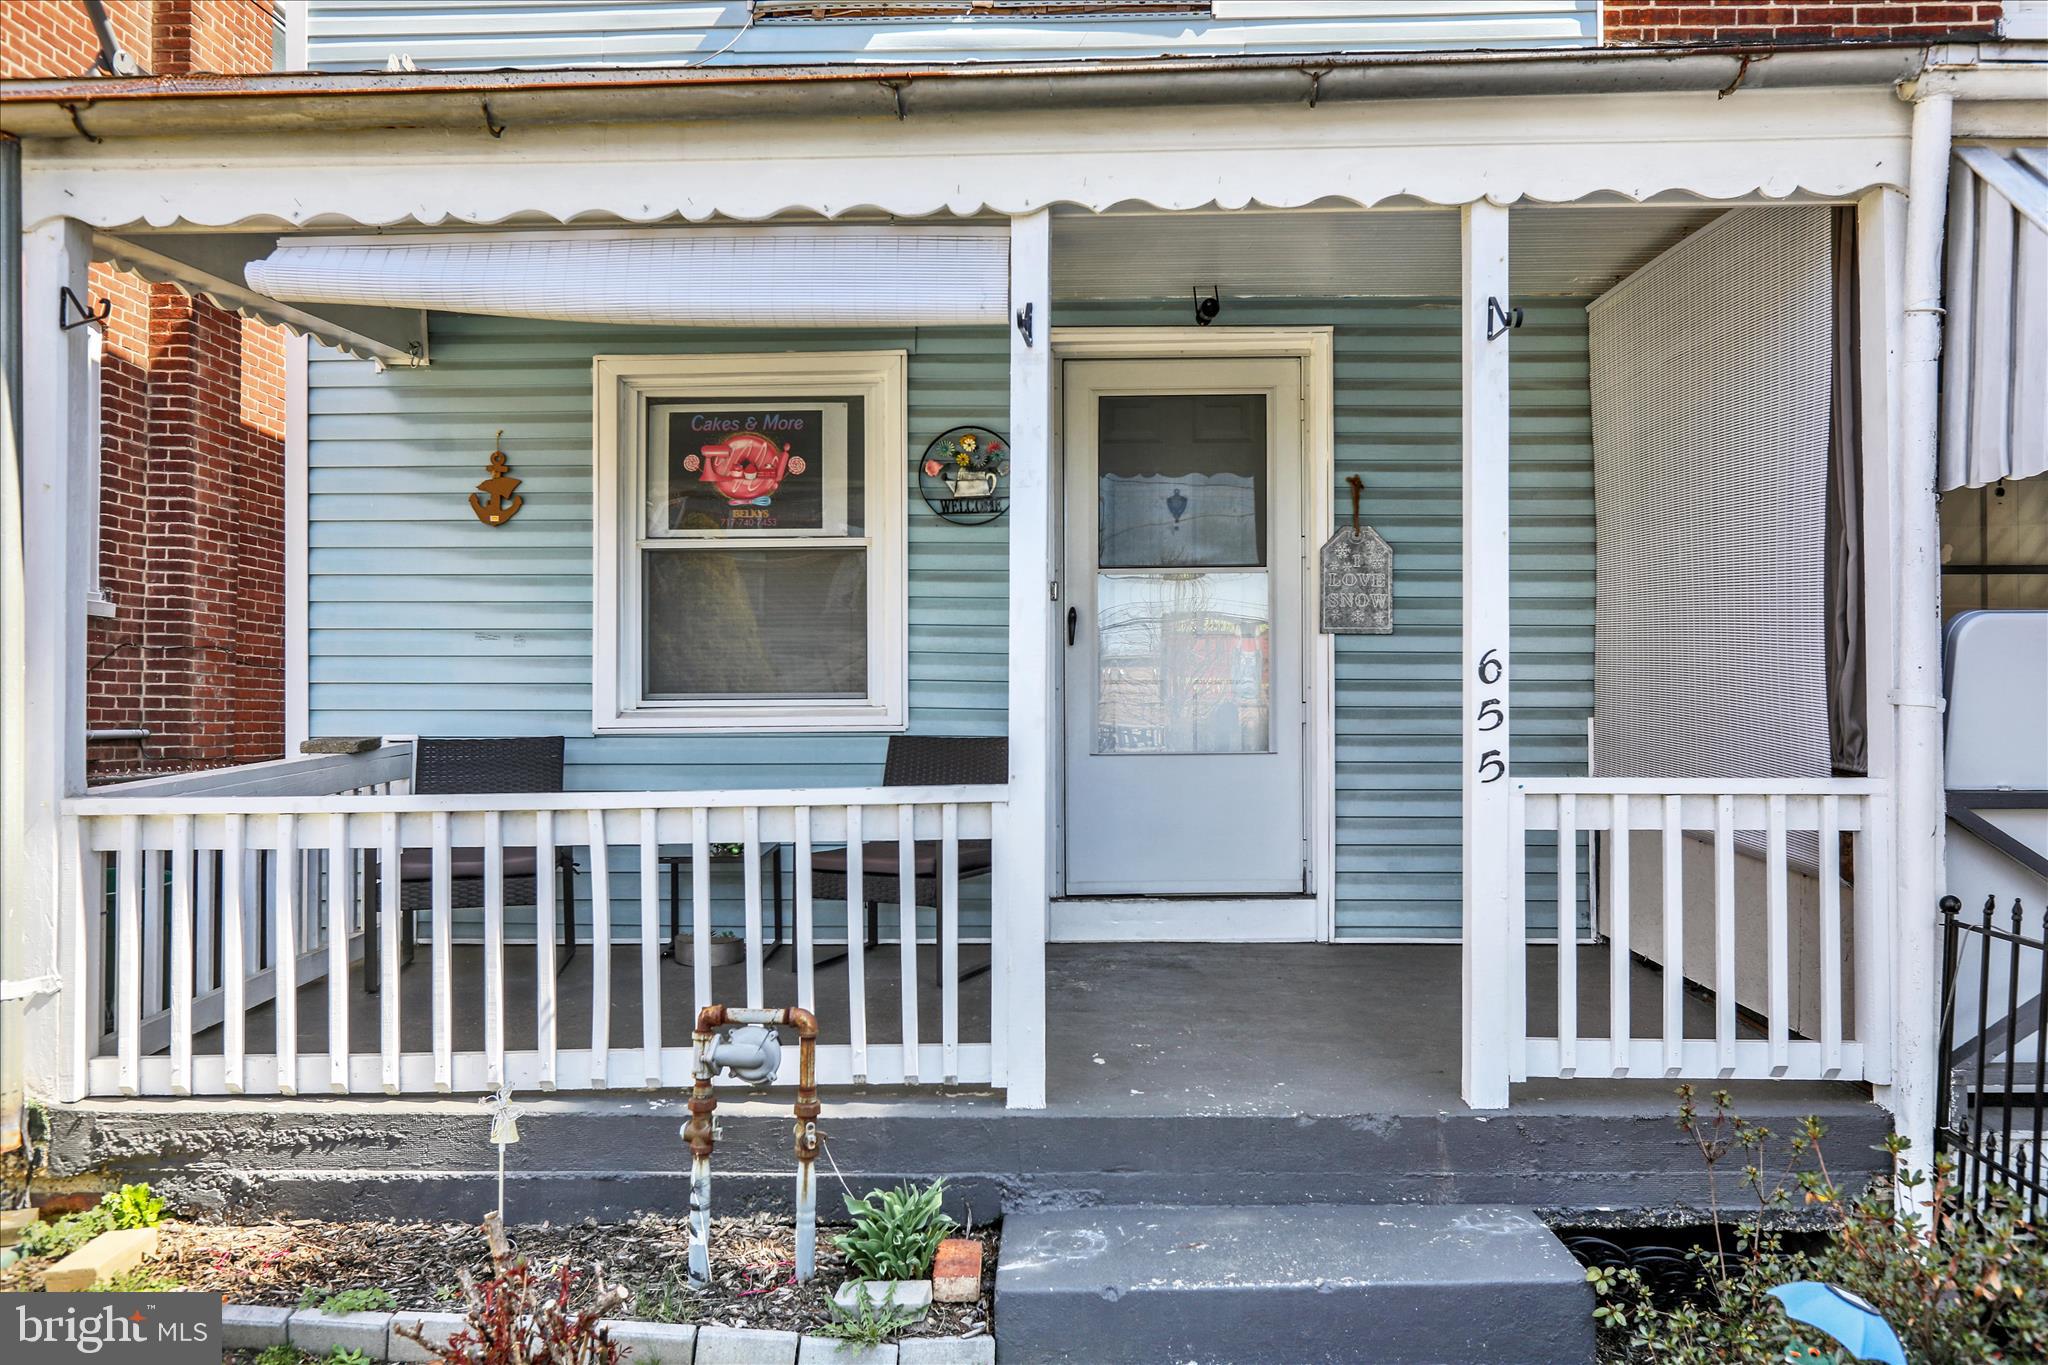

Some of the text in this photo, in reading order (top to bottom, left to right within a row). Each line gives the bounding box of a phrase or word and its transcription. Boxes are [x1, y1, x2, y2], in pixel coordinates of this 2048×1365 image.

[691, 414, 804, 432] Cakes & More
[732, 509, 769, 518] BELKYS
[940, 500, 1002, 513] WELCOME
[1353, 554, 1361, 568] I
[1328, 573, 1386, 588] LOVE
[1327, 592, 1389, 608] SNOW
[1477, 648, 1506, 783] 655
